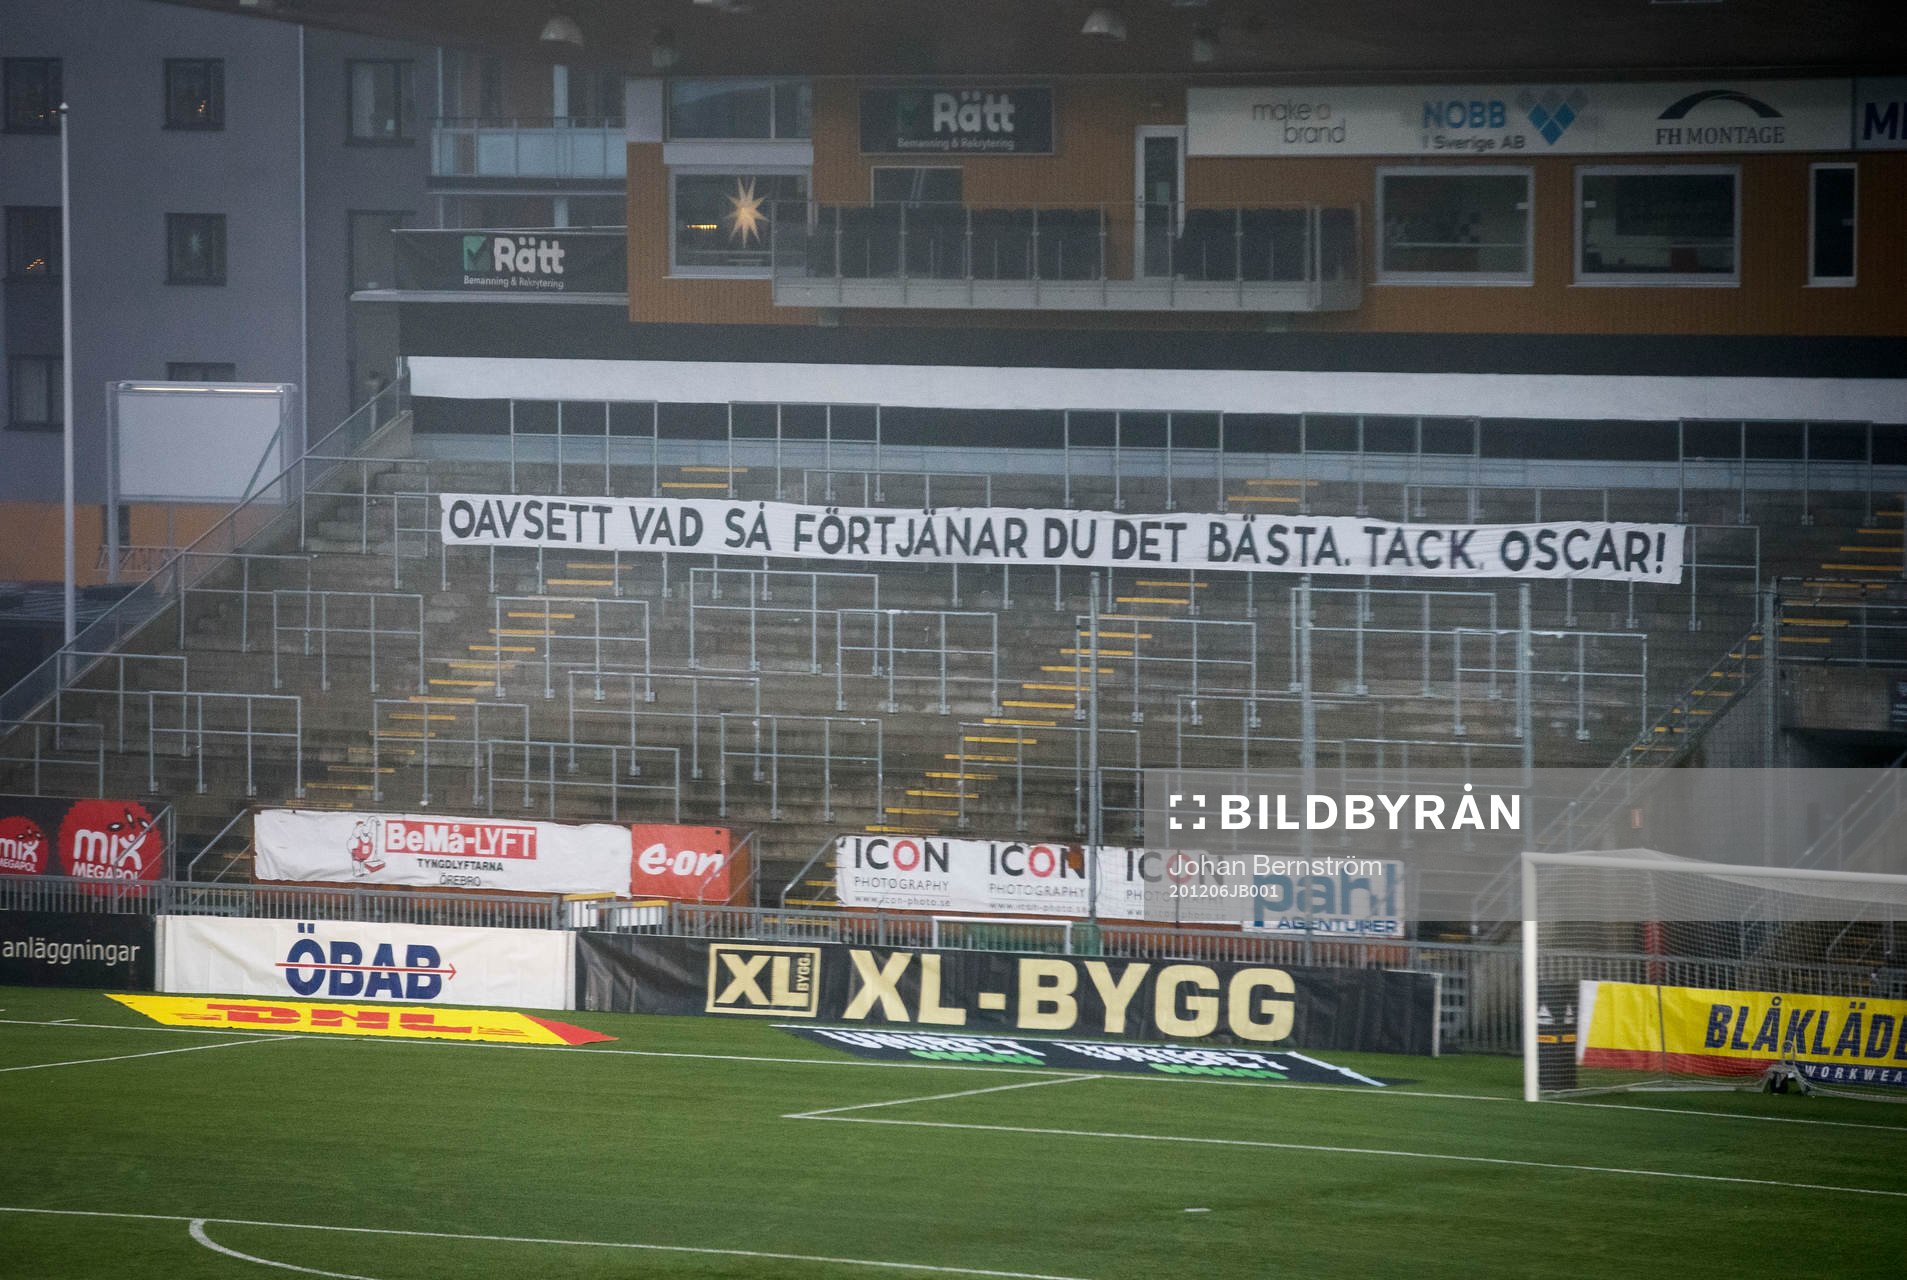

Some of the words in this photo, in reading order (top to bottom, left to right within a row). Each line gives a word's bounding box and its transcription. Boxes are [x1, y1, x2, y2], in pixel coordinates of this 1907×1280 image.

[933, 91, 1015, 132] Rätt
[1253, 99, 1311, 121] make
[1316, 103, 1331, 120] a
[1422, 100, 1506, 129] NOBB
[1863, 101, 1907, 141] M
[1284, 117, 1345, 144] brand
[1433, 134, 1495, 152] Sverige
[1501, 134, 1525, 149] AB
[1656, 127, 1682, 145] FH
[1686, 126, 1785, 145] MONTAGE
[494, 237, 565, 274] Rätt
[463, 275, 509, 288] Bemanning
[511, 276, 517, 287] &
[450, 499, 613, 545] OAVSETT
[628, 505, 704, 547] VAD
[724, 502, 772, 552] SÅ
[793, 506, 1029, 559] FÖRTJÄNAR
[1043, 517, 1097, 559] DU
[1111, 518, 1188, 563] DET
[1207, 514, 1350, 567] BÄSTA.
[1500, 529, 1666, 574] OSCAR!
[386, 822, 536, 858] BeMå-LYFT
[0, 858, 37, 873] EGAPOL
[417, 858, 504, 872] TYNGDLYFTARNA
[855, 837, 950, 874] ICON
[990, 843, 1086, 879] ICON
[1126, 850, 1224, 885] ICON
[440, 872, 481, 887] ÖREBRO
[854, 876, 950, 892] PHOTOGRAPHY
[989, 882, 1087, 899] PHOTOGRAPHY
[854, 895, 951, 907] www.icon-photo.se
[2, 937, 140, 966] anläggningar
[285, 923, 443, 1000] ÖBAB
[718, 954, 810, 1010] XL
[796, 957, 811, 991] BYGG
[843, 948, 1297, 1042] XL-BYGG
[206, 1003, 473, 1034] DHL
[1804, 1064, 1903, 1083] WORKWEA
